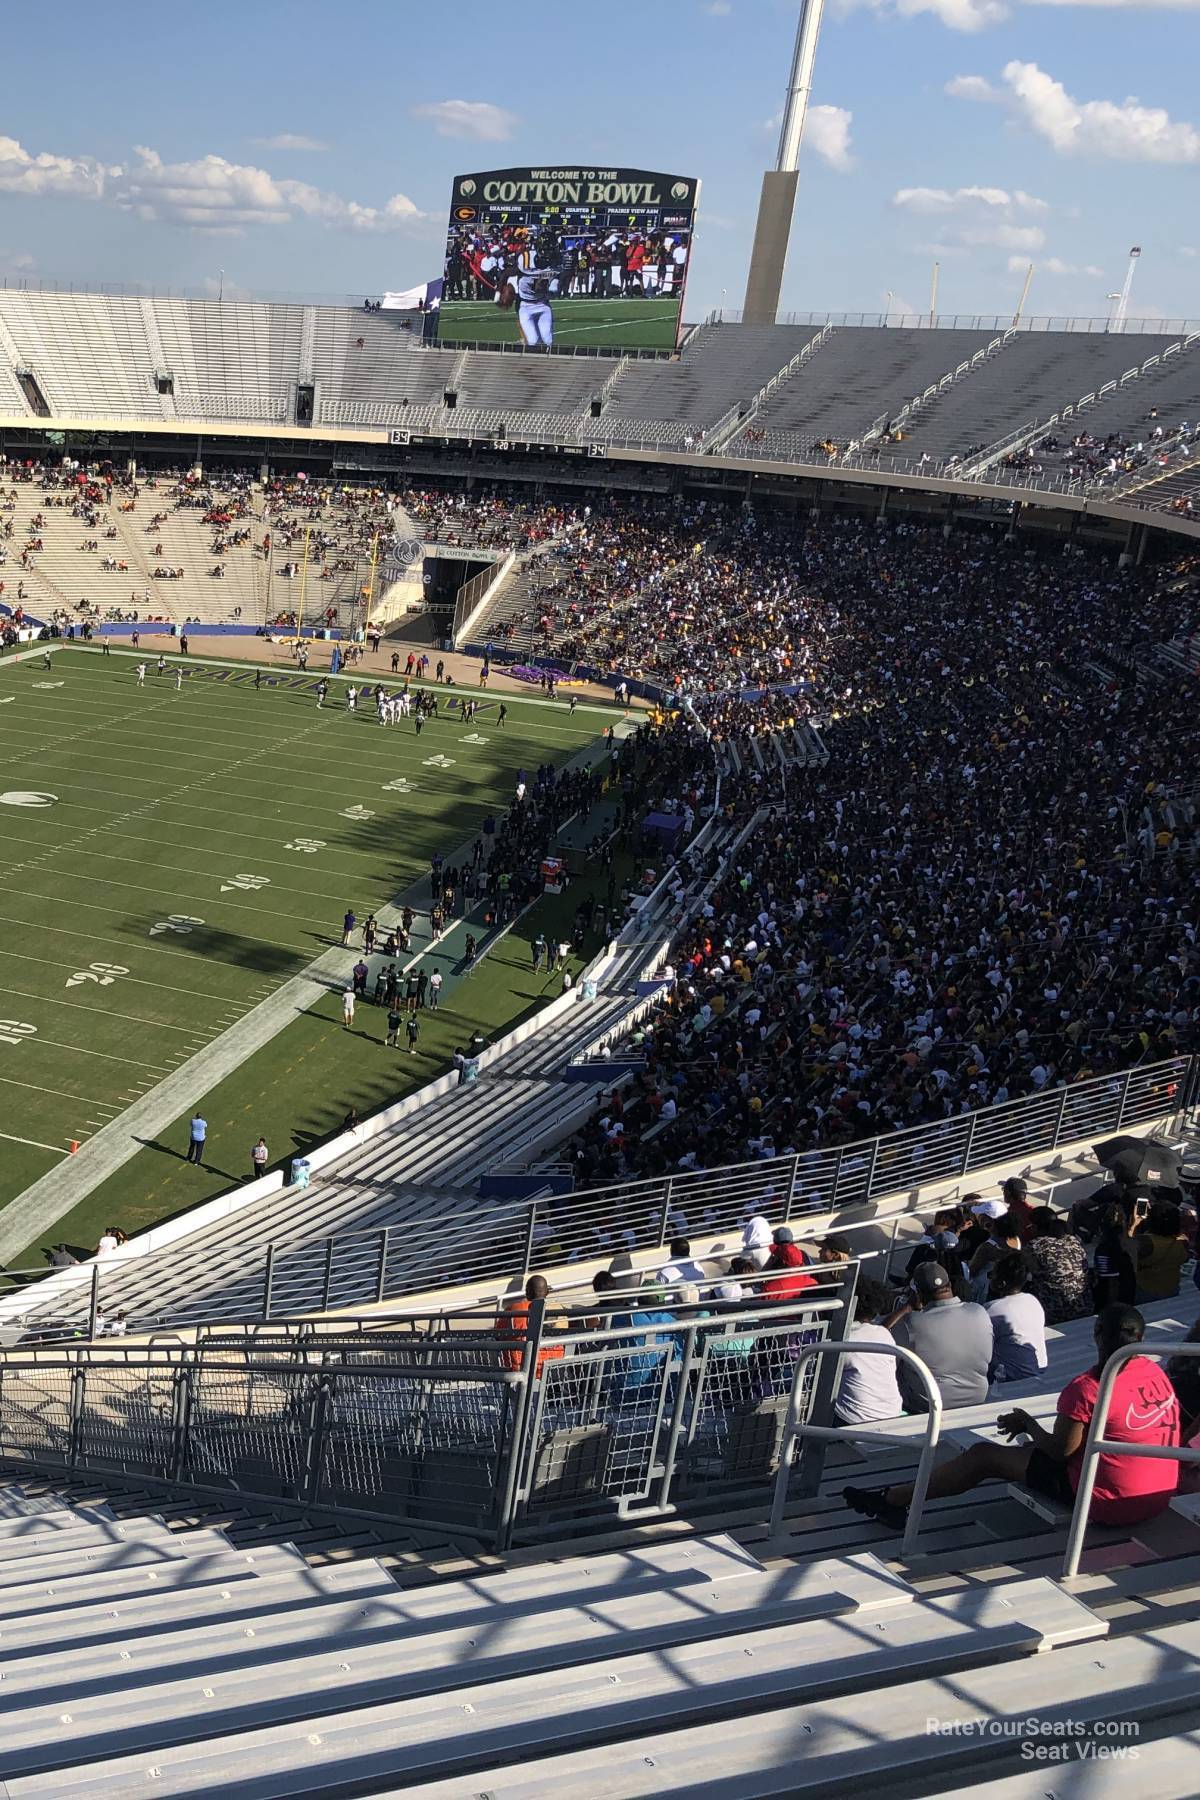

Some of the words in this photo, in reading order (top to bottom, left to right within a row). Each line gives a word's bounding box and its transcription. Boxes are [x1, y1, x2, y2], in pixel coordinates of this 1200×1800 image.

[531, 171, 579, 179] WELCOME
[483, 181, 583, 203] COTTON
[585, 183, 661, 204] BOWL
[501, 213, 508, 222] 7
[628, 216, 636, 226] 7
[394, 432, 408, 441] 34
[494, 442, 508, 450] 5:20
[592, 445, 604, 455] 34
[283, 838, 327, 853] 50
[227, 874, 271, 890] 40
[154, 914, 205, 934] 30
[72, 963, 130, 986] 20
[644, 1758, 654, 1766] 5
